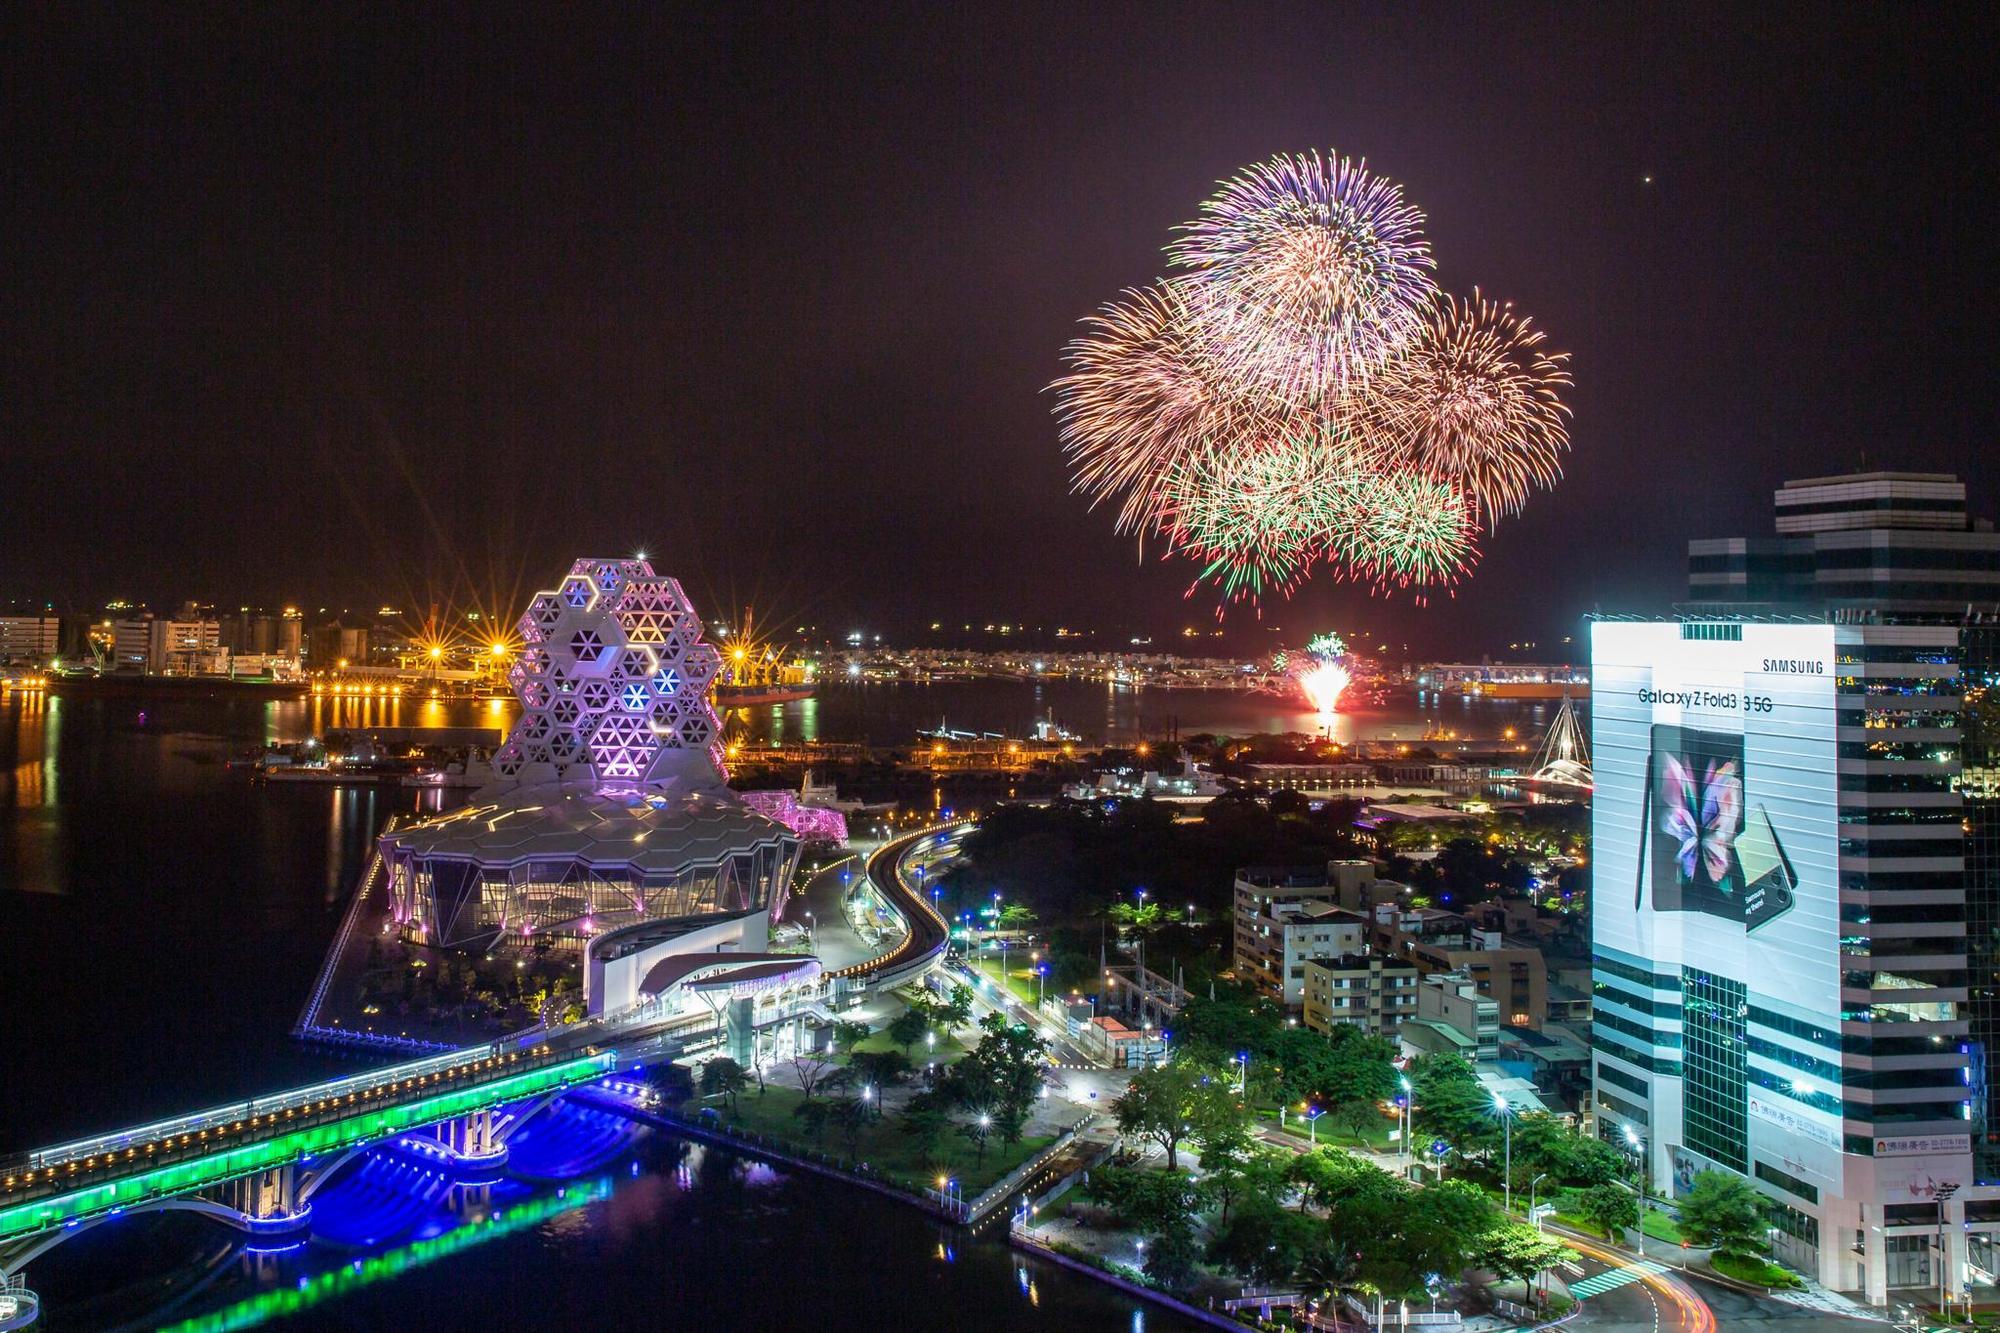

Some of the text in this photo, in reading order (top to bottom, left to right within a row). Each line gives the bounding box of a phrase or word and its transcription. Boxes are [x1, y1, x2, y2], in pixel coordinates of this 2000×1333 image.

[1763, 659, 1823, 674] SAMSUNG
[1638, 688, 1693, 709] Galaxy
[1693, 691, 1701, 706] Z
[1703, 692, 1737, 709] Fold3
[1754, 696, 1773, 712] 5G
